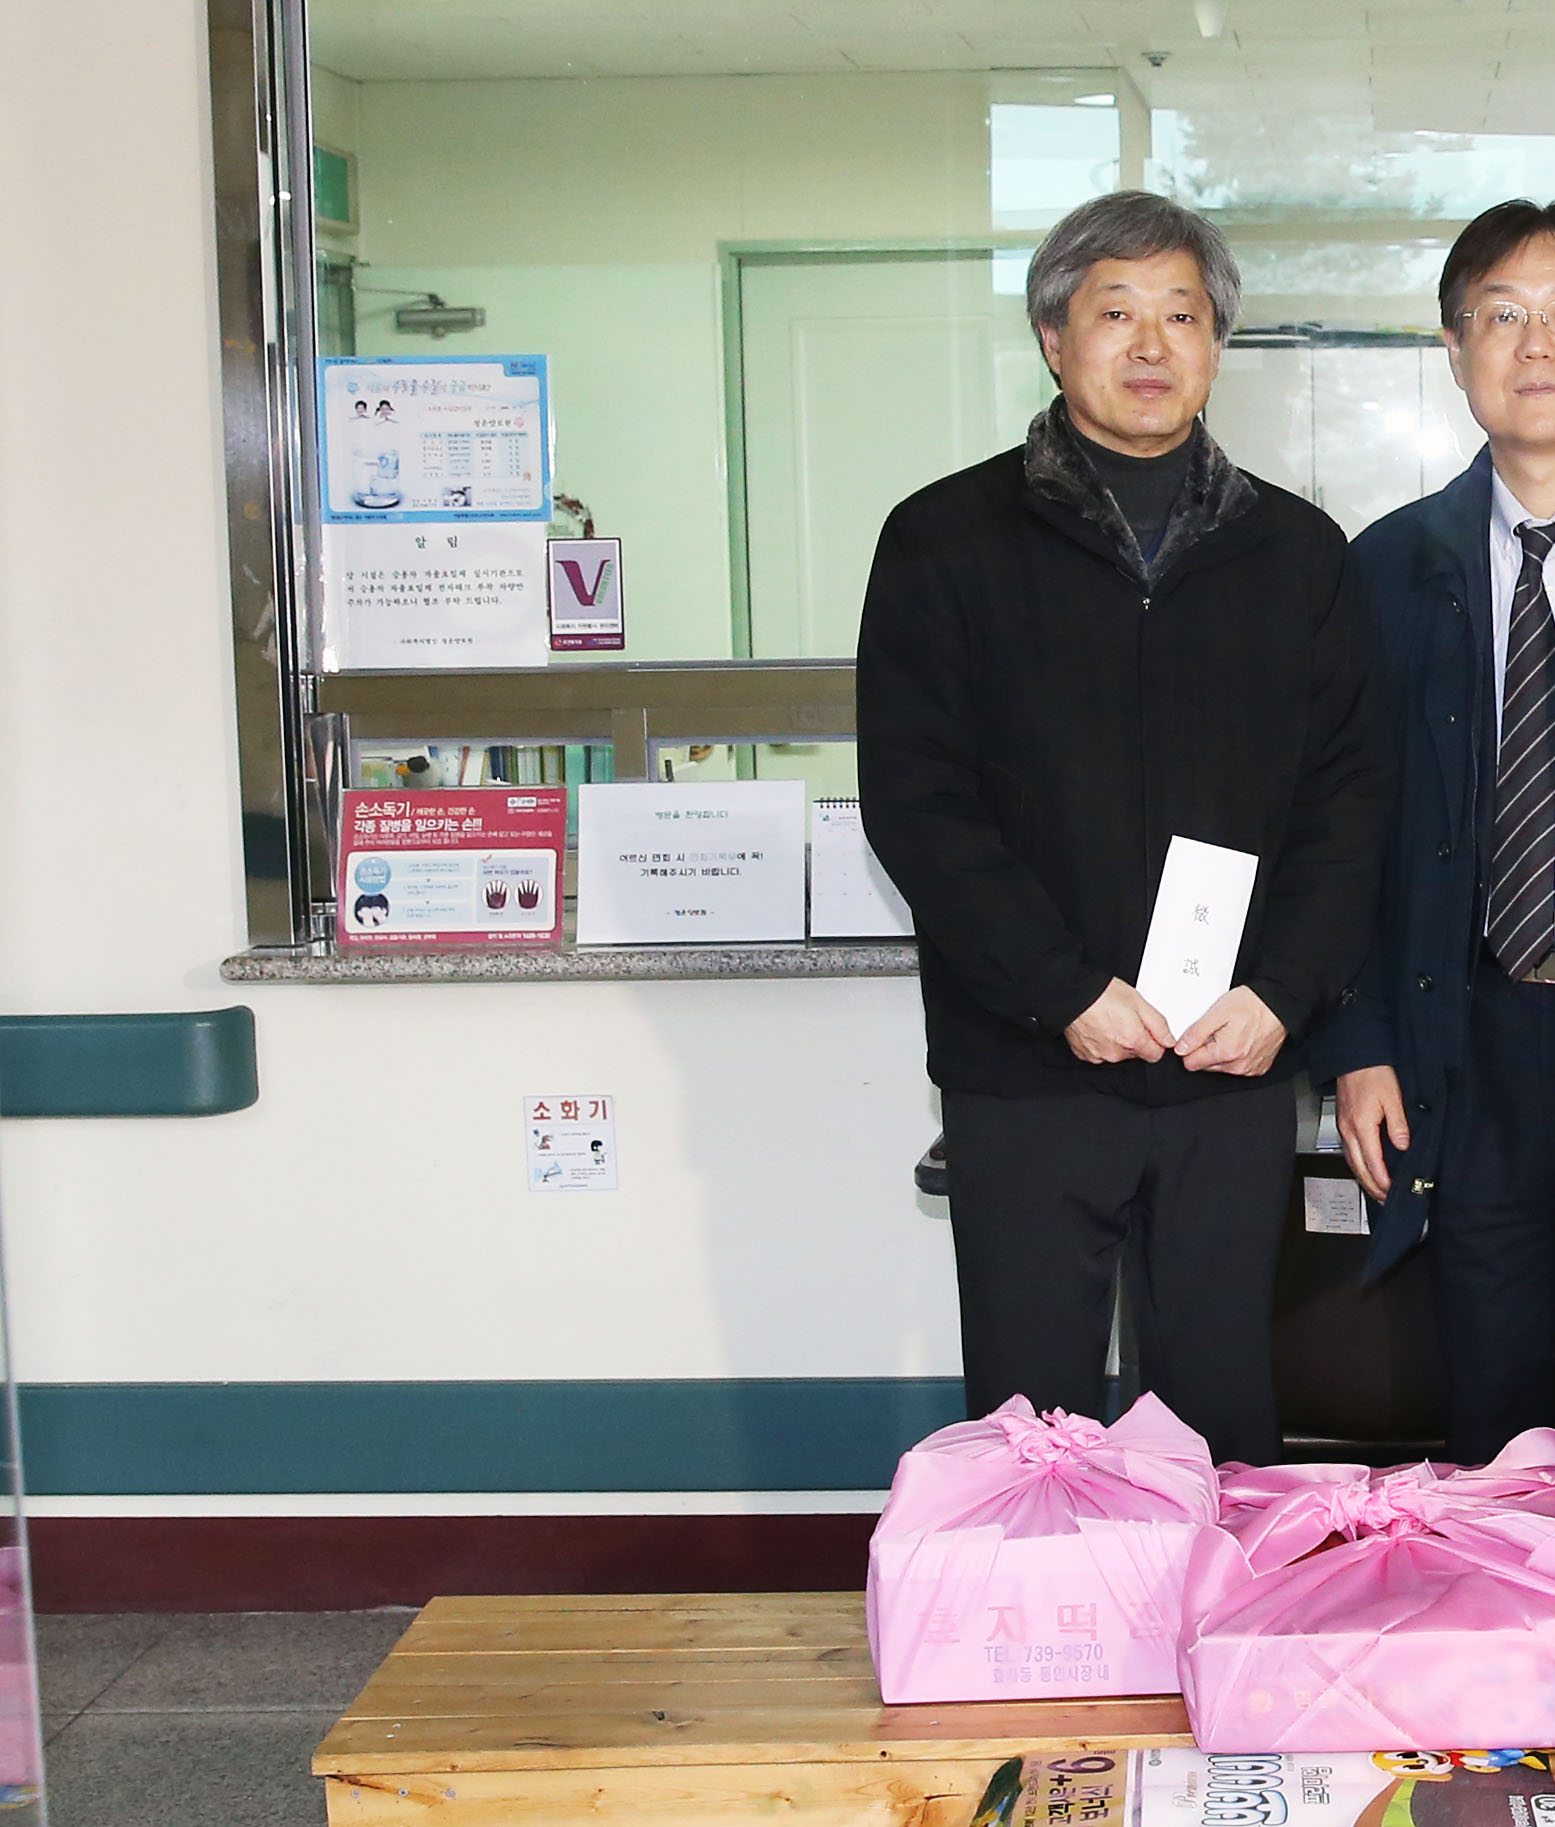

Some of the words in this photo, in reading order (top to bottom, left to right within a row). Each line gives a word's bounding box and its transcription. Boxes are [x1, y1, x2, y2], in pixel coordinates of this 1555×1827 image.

[354, 801, 411, 819] 손소독기
[354, 820, 376, 833] 각종
[379, 819, 412, 833] 질병을
[415, 818, 459, 832] 일으키는
[619, 853, 647, 863] 어르신
